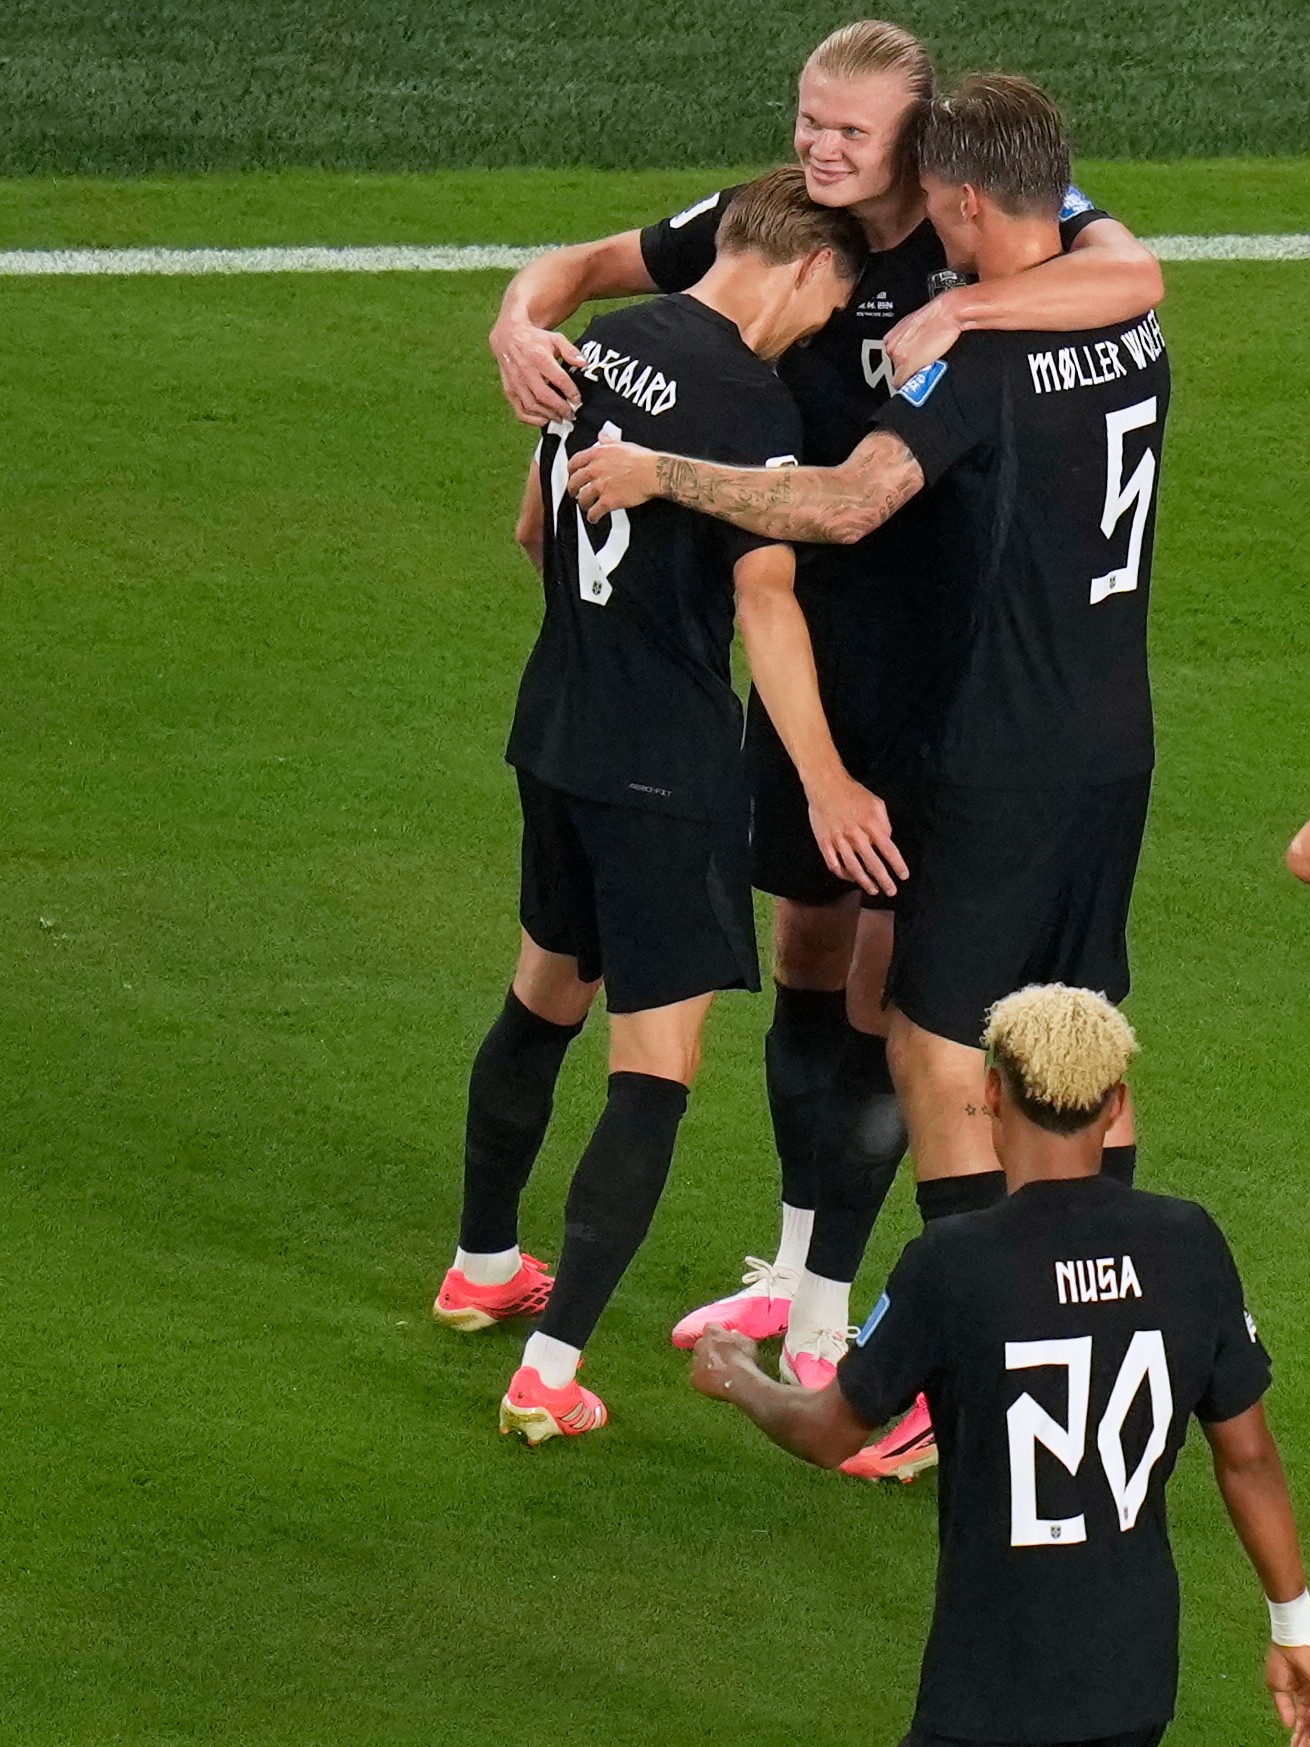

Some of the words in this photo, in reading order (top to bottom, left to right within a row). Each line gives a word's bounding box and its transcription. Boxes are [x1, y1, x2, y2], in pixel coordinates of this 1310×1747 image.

[1027, 340, 1127, 394] MØLLER
[1090, 396, 1157, 605] 5
[1055, 1255, 1142, 1304] NUSA
[1005, 1330, 1174, 1547] 20
